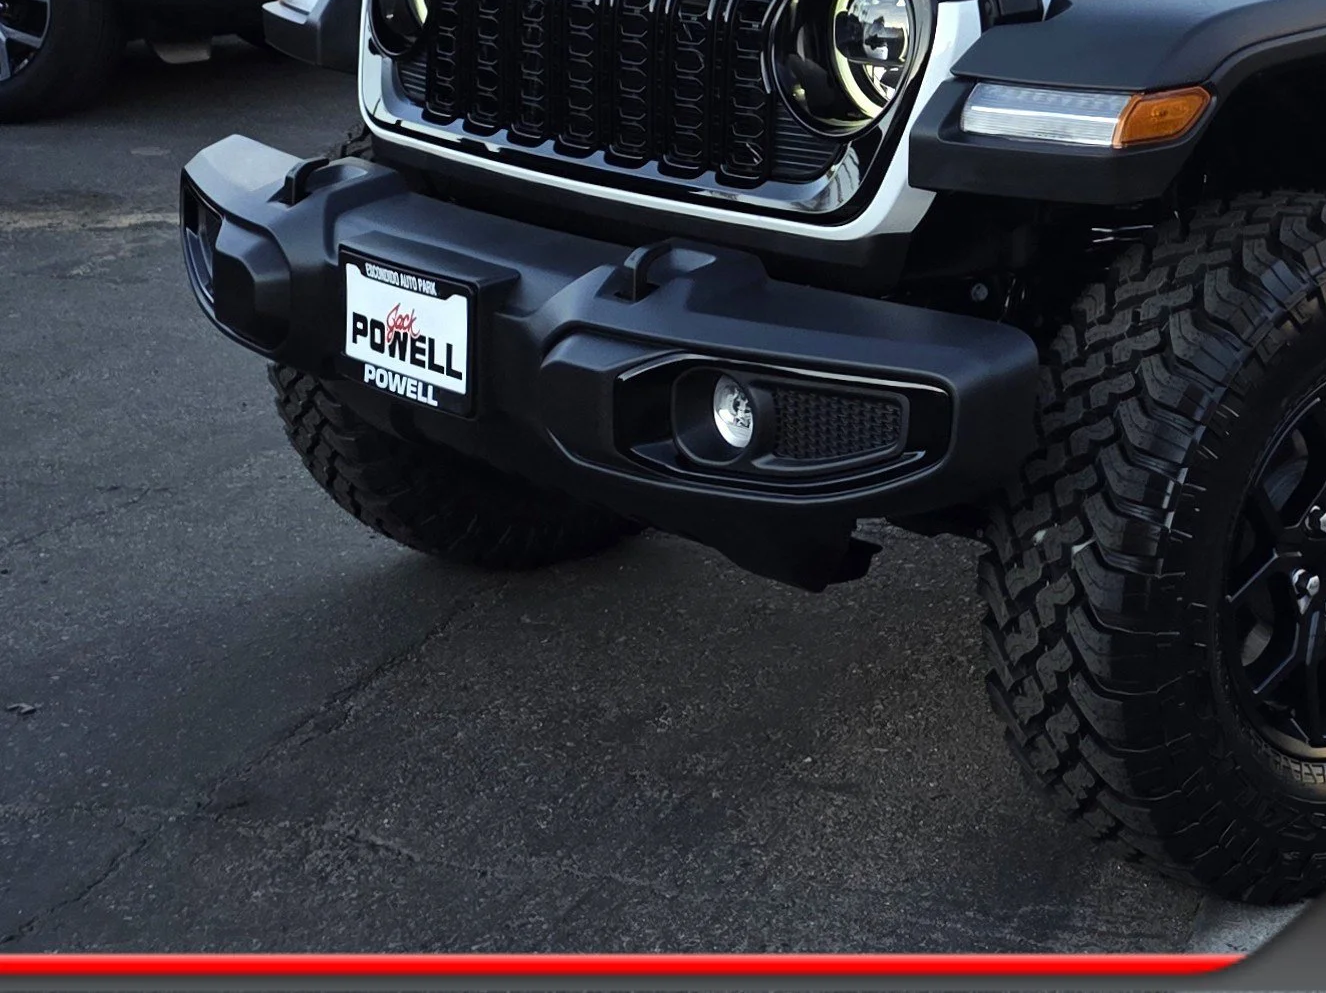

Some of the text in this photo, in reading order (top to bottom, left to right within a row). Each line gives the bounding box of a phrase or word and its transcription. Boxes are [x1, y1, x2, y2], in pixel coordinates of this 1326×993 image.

[400, 272, 418, 292] AUTO
[417, 277, 437, 296] PARK
[385, 302, 421, 344] Jack
[351, 310, 464, 381] POWELL
[363, 363, 439, 407] POWELL
